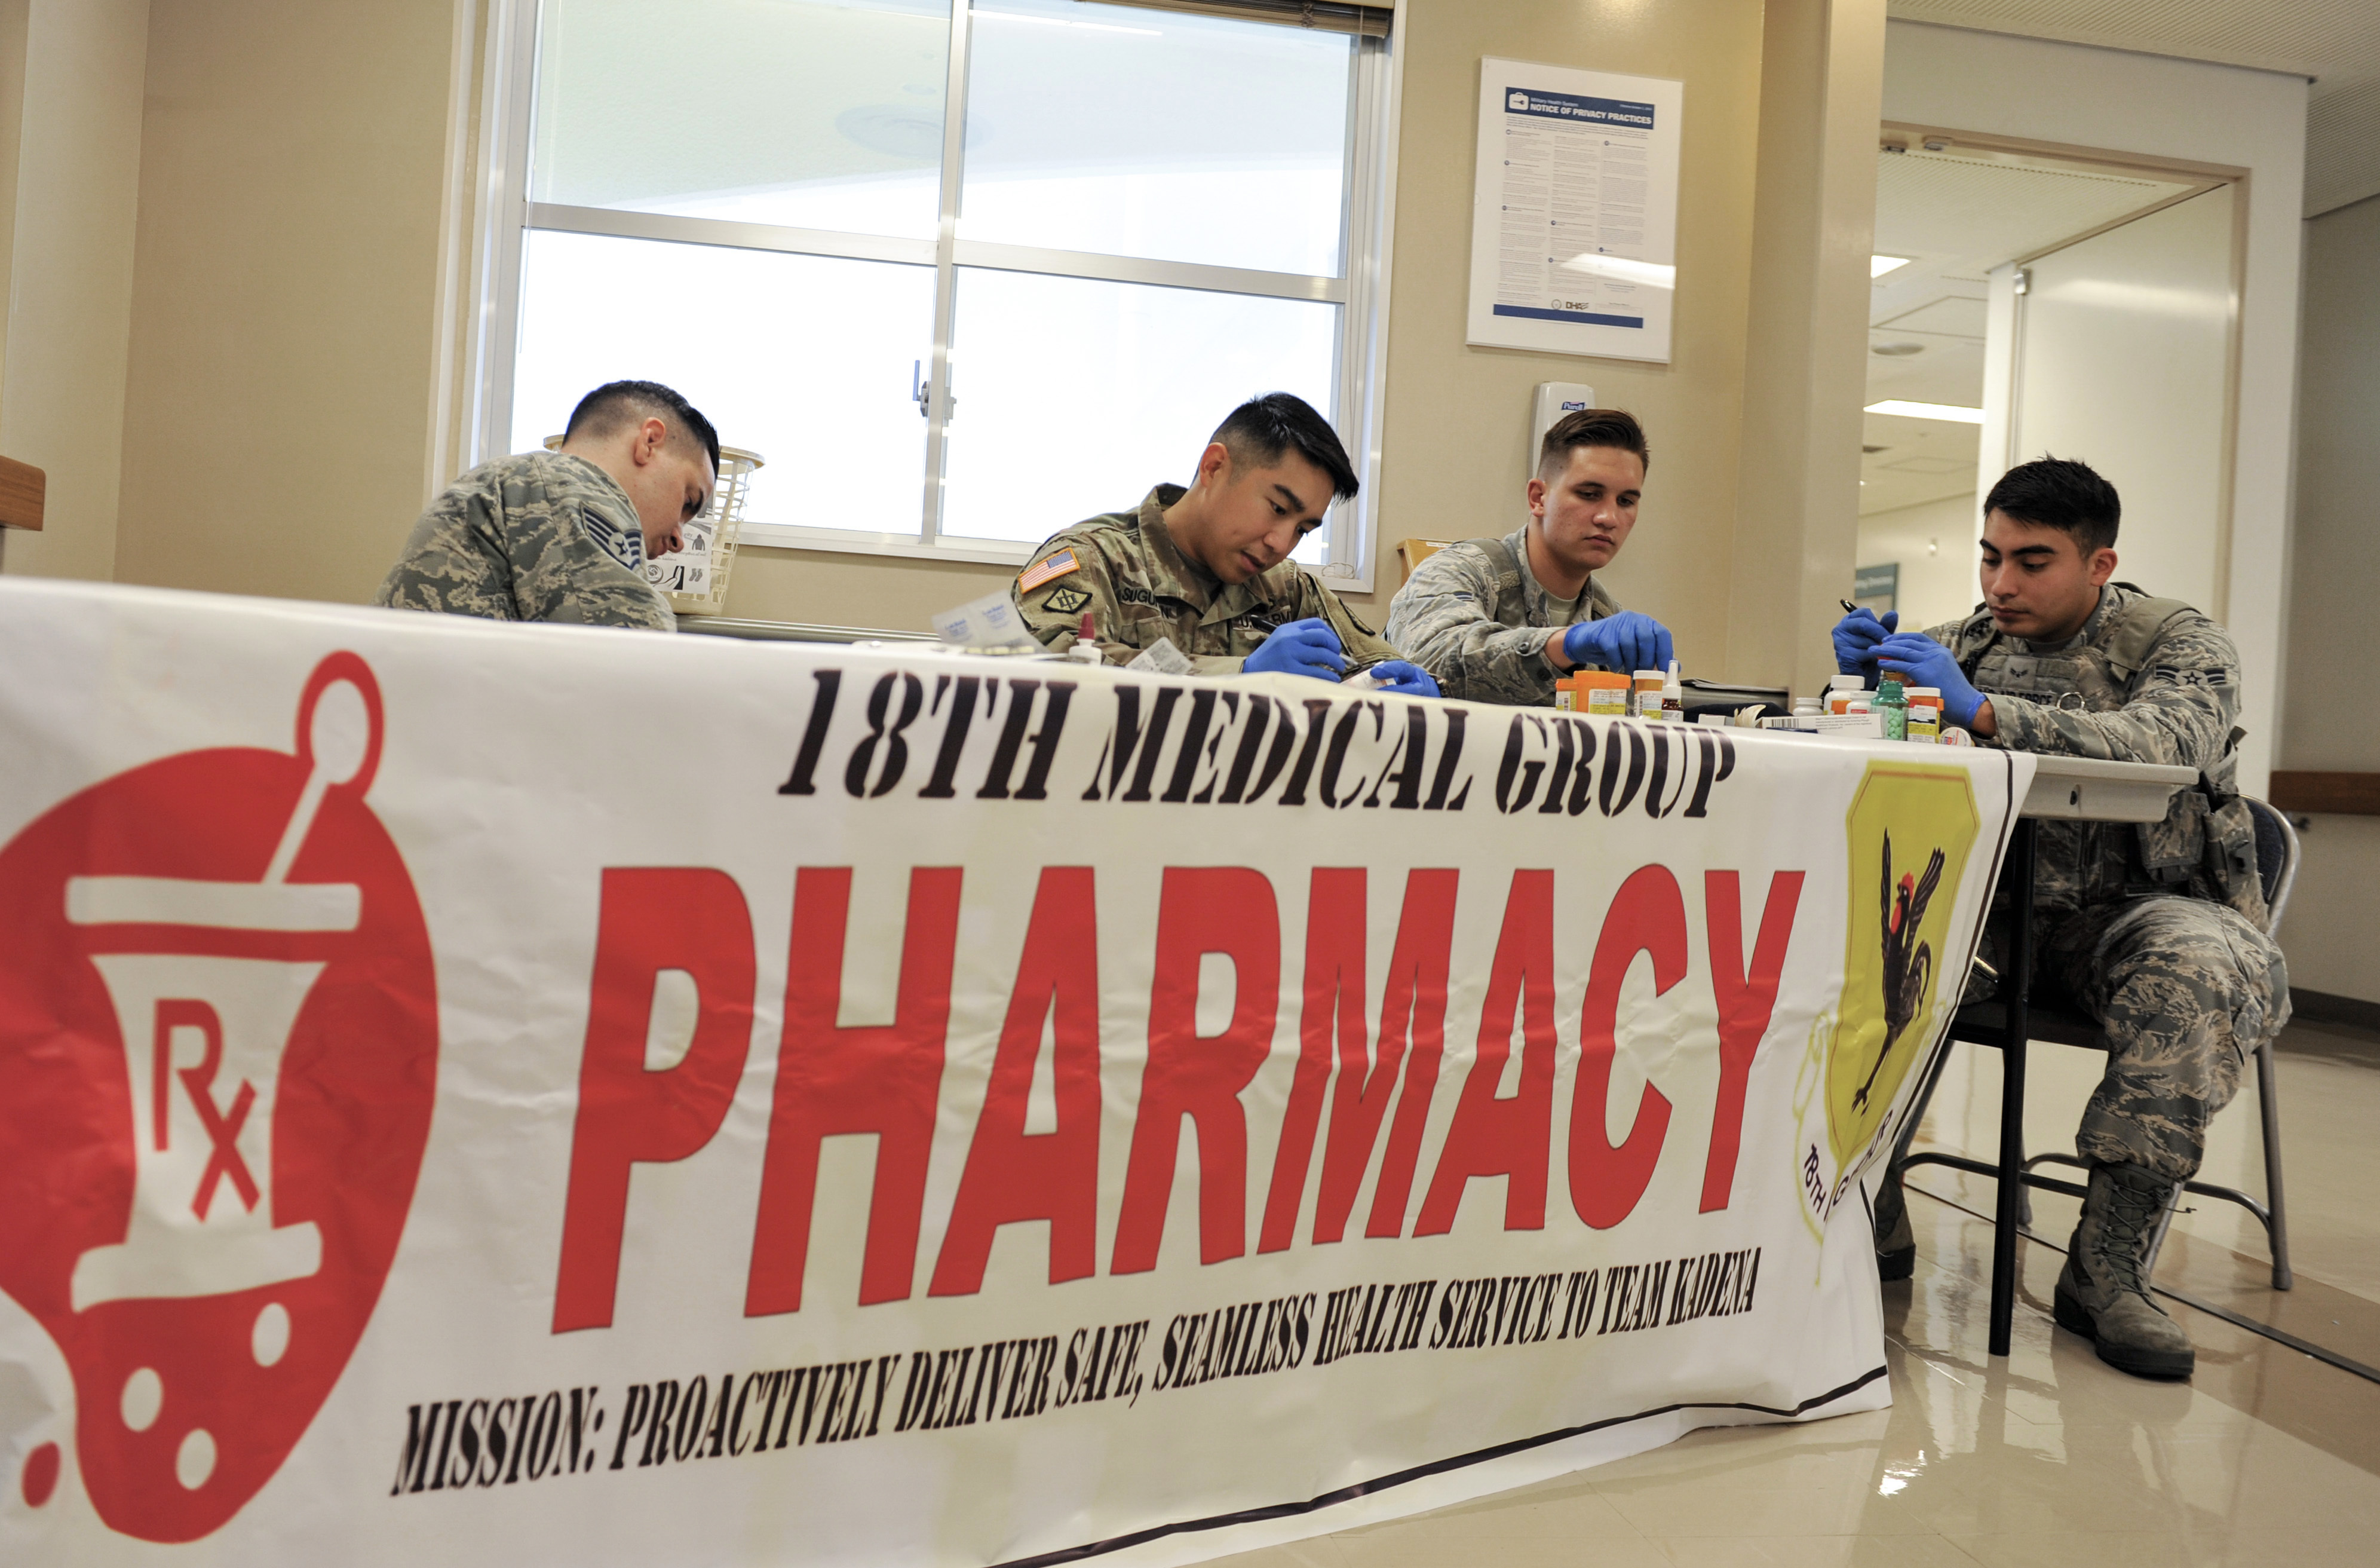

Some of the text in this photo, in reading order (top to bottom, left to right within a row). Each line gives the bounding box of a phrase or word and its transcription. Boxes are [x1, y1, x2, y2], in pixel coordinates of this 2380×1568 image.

[1530, 103, 1560, 114] NOTICE
[1572, 108, 1607, 119] PRIVACY
[1608, 112, 1652, 124] PRACTICES
[778, 671, 1735, 818] 18TH MEDICAL GROUP
[553, 865, 1805, 1333] PHARMACY
[1804, 1143, 1827, 1214] 18TH
[392, 1248, 1761, 1496] MISSION: PROACTIVELY DELIVER SAFE, SEAMLESS HEALTH SERVICE TO TEAM KADENA
